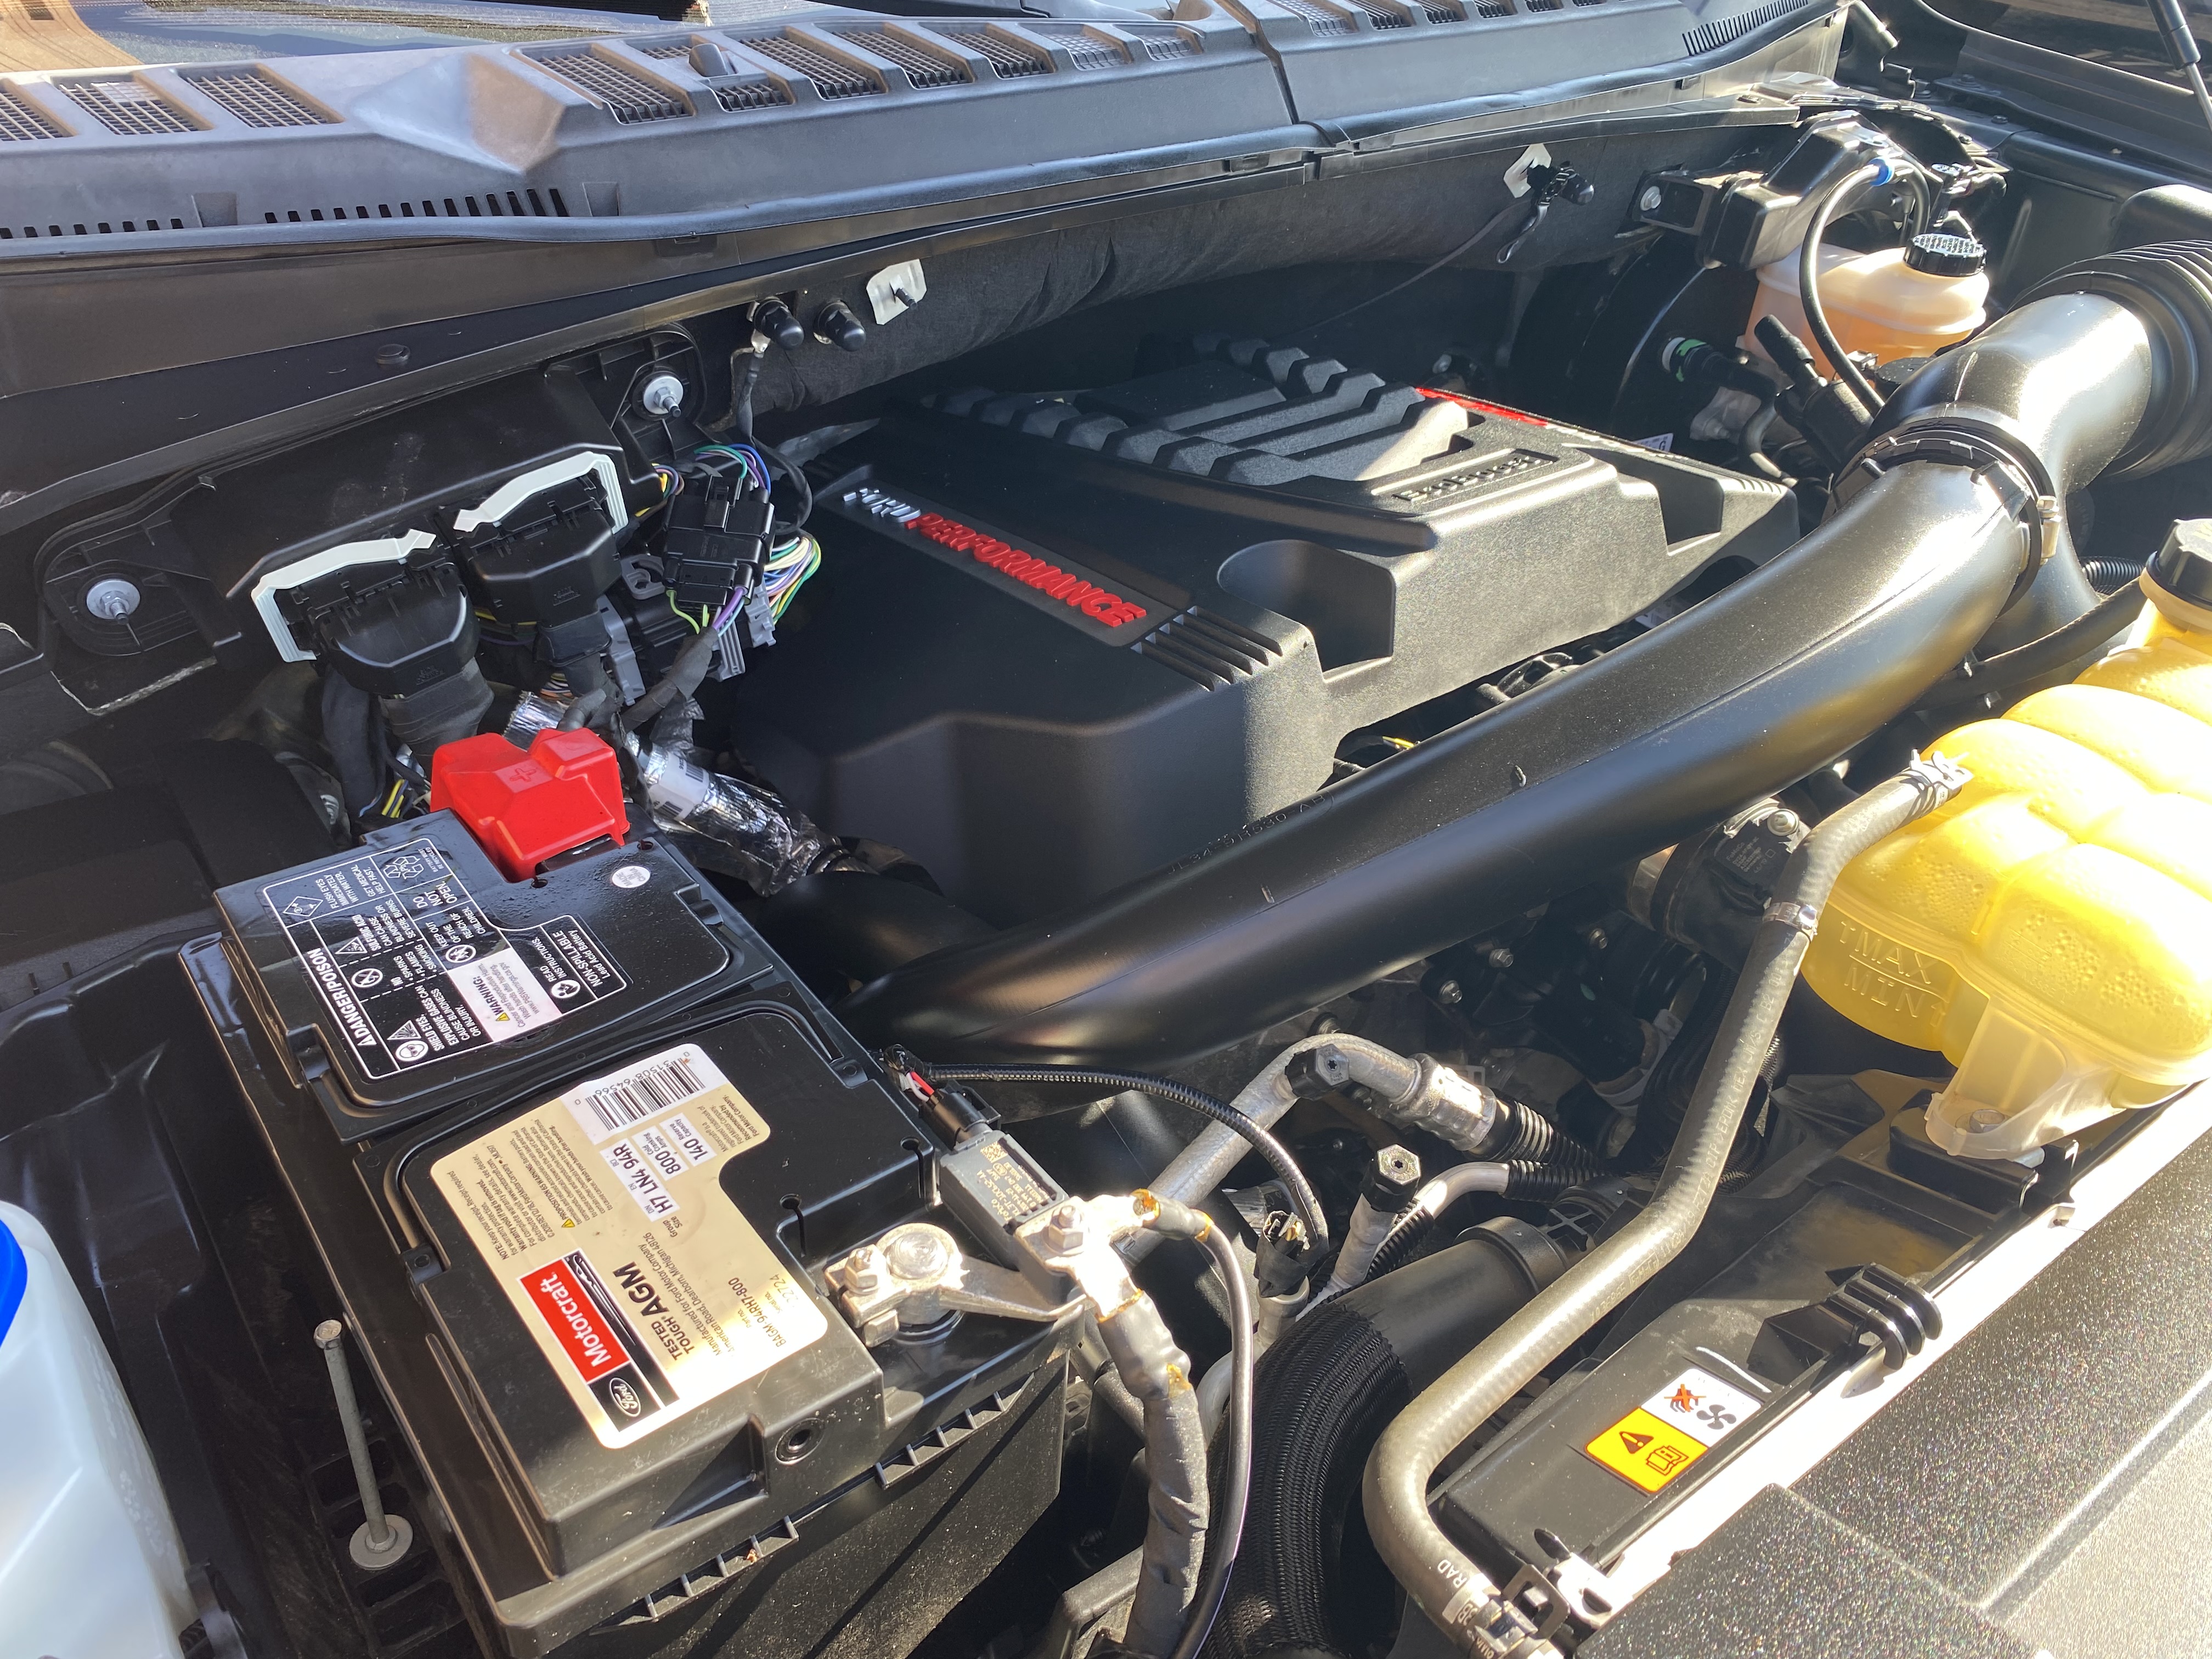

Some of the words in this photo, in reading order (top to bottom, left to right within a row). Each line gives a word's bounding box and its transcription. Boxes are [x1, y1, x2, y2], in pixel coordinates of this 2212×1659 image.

[904, 512, 1147, 628] PERFORMANCE
[418, 849, 427, 857] MUST
[425, 847, 439, 864] RECYCLED
[425, 857, 438, 872] BATTERY
[335, 871, 351, 890] WATER.
[351, 864, 369, 886] MEDICAL
[363, 867, 377, 881] FAST.
[616, 872, 633, 887] MADE
[629, 867, 646, 882] CHINA
[315, 878, 329, 892] EYES
[324, 874, 349, 905] IMMEDIATELY
[363, 887, 375, 896] GET
[371, 881, 385, 894] HELP
[436, 881, 457, 903] OPEN.
[324, 891, 339, 909] FLUSH
[345, 889, 358, 902] WITH
[413, 896, 428, 908] DO
[424, 890, 443, 906] NOT
[375, 905, 385, 913] OR
[385, 898, 402, 917] BURNS.
[352, 914, 366, 926] ACID
[368, 916, 385, 934] CAUSE
[380, 913, 404, 942] BLINDNESS
[397, 917, 416, 938] SEVERE
[425, 922, 438, 932] OUT
[455, 919, 473, 938] REACH
[462, 906, 486, 934] CHILDREN.
[359, 926, 381, 950] SULFURIC
[443, 924, 455, 935] THE
[449, 934, 461, 943] OF
[380, 934, 392, 946] CAN
[433, 933, 448, 947] KEEP
[568, 930, 588, 951] Battery
[405, 951, 425, 974] FLAMES
[414, 944, 436, 969] SMOKING
[532, 936, 567, 978] INSTRUCTIONS.
[552, 930, 602, 986] NON-SPILLABLE
[582, 950, 599, 963] Acid
[1854, 931, 1939, 985] MAX
[393, 955, 413, 978] SPARKS
[478, 964, 488, 977] Harm.
[490, 964, 505, 984] handling.
[540, 966, 557, 981] READ
[592, 963, 610, 979] Lead
[391, 977, 403, 985] NO
[486, 976, 508, 1003] Reproductive
[499, 962, 539, 1014] www.P65Warnings.ca.gov
[502, 983, 512, 992] after
[307, 948, 371, 1038] DANGER/POISON
[415, 985, 428, 997] CAN
[473, 976, 503, 1015] WARNING:
[509, 992, 520, 1006] hands
[1843, 963, 1922, 1019] MIN
[421, 997, 440, 1015] GASES
[431, 989, 457, 1020] BLINDNESS
[504, 1002, 514, 1011] and
[518, 1006, 531, 1019] Wash
[416, 1014, 432, 1031] EYES.
[455, 1005, 475, 1027] INJURY.
[511, 1011, 525, 1027] Cancer
[433, 1014, 459, 1045] EXPLOSIVE
[451, 1019, 470, 1040] CAUSE
[470, 1026, 481, 1036] OR
[425, 1030, 444, 1051] SHIELD
[635, 1058, 672, 1081] 31508
[595, 1076, 631, 1099] 64566
[723, 1095, 741, 1115] Company.
[702, 1109, 720, 1129] trademark
[710, 1105, 726, 1124] Company.
[738, 1114, 749, 1127] Motor
[669, 1124, 684, 1139] Reserve
[675, 1119, 691, 1136] Capacity
[723, 1110, 751, 1140] Recommended
[724, 1123, 736, 1135] Motor
[748, 1126, 759, 1136] Ford
[510, 1138, 520, 1150] posts,
[644, 1133, 660, 1151] Cranking
[655, 1136, 667, 1148] Amps
[717, 1128, 736, 1147] registered
[732, 1133, 743, 1144] Ford
[517, 1149, 529, 1164] Battery
[613, 1143, 639, 1169] 94R
[642, 1144, 653, 1154] Cold
[684, 1139, 707, 1160] 140
[655, 1151, 680, 1173] 800
[447, 1171, 463, 1189] required
[526, 1164, 543, 1184] WARNING:
[631, 1169, 657, 1194] LN4
[459, 1188, 474, 1206] Receipt
[476, 1179, 494, 1201] removed.
[494, 1204, 503, 1214] tag
[544, 1189, 567, 1220] PROPOSITION
[645, 1205, 654, 1213] DIN
[650, 1195, 673, 1212] H7
[991, 1198, 1012, 1221] FoMoCo
[470, 1204, 484, 1222] receipt.
[481, 1201, 501, 1227] protection.
[500, 1216, 512, 1228] void
[671, 1216, 682, 1228] Size
[481, 1221, 492, 1232] your
[662, 1220, 678, 1237] Group
[488, 1231, 499, 1244] Keep
[496, 1226, 513, 1247] warranty
[509, 1227, 527, 1251] Warranty
[643, 1232, 659, 1249] 48126
[495, 1243, 509, 1259] NOTE:
[638, 1244, 661, 1271] Company
[657, 1249, 680, 1276] Michigan
[657, 1270, 673, 1289] Motor
[613, 1262, 668, 1316] AGM
[668, 1287, 684, 1302] Ford
[677, 1274, 701, 1305] Dearborn,
[763, 1291, 774, 1300] no.
[680, 1301, 691, 1312] for
[697, 1304, 714, 1324] Road,
[726, 1276, 789, 1347] BAGM-94RH7-800
[735, 1308, 746, 1318] no.
[540, 1273, 611, 1366] Motorcraft
[741, 1316, 754, 1328] Part
[651, 1321, 682, 1359] TESTED
[685, 1311, 720, 1356] Manufactured
[613, 1381, 637, 1411] Ford
[1435, 1559, 1470, 1590] RAD
